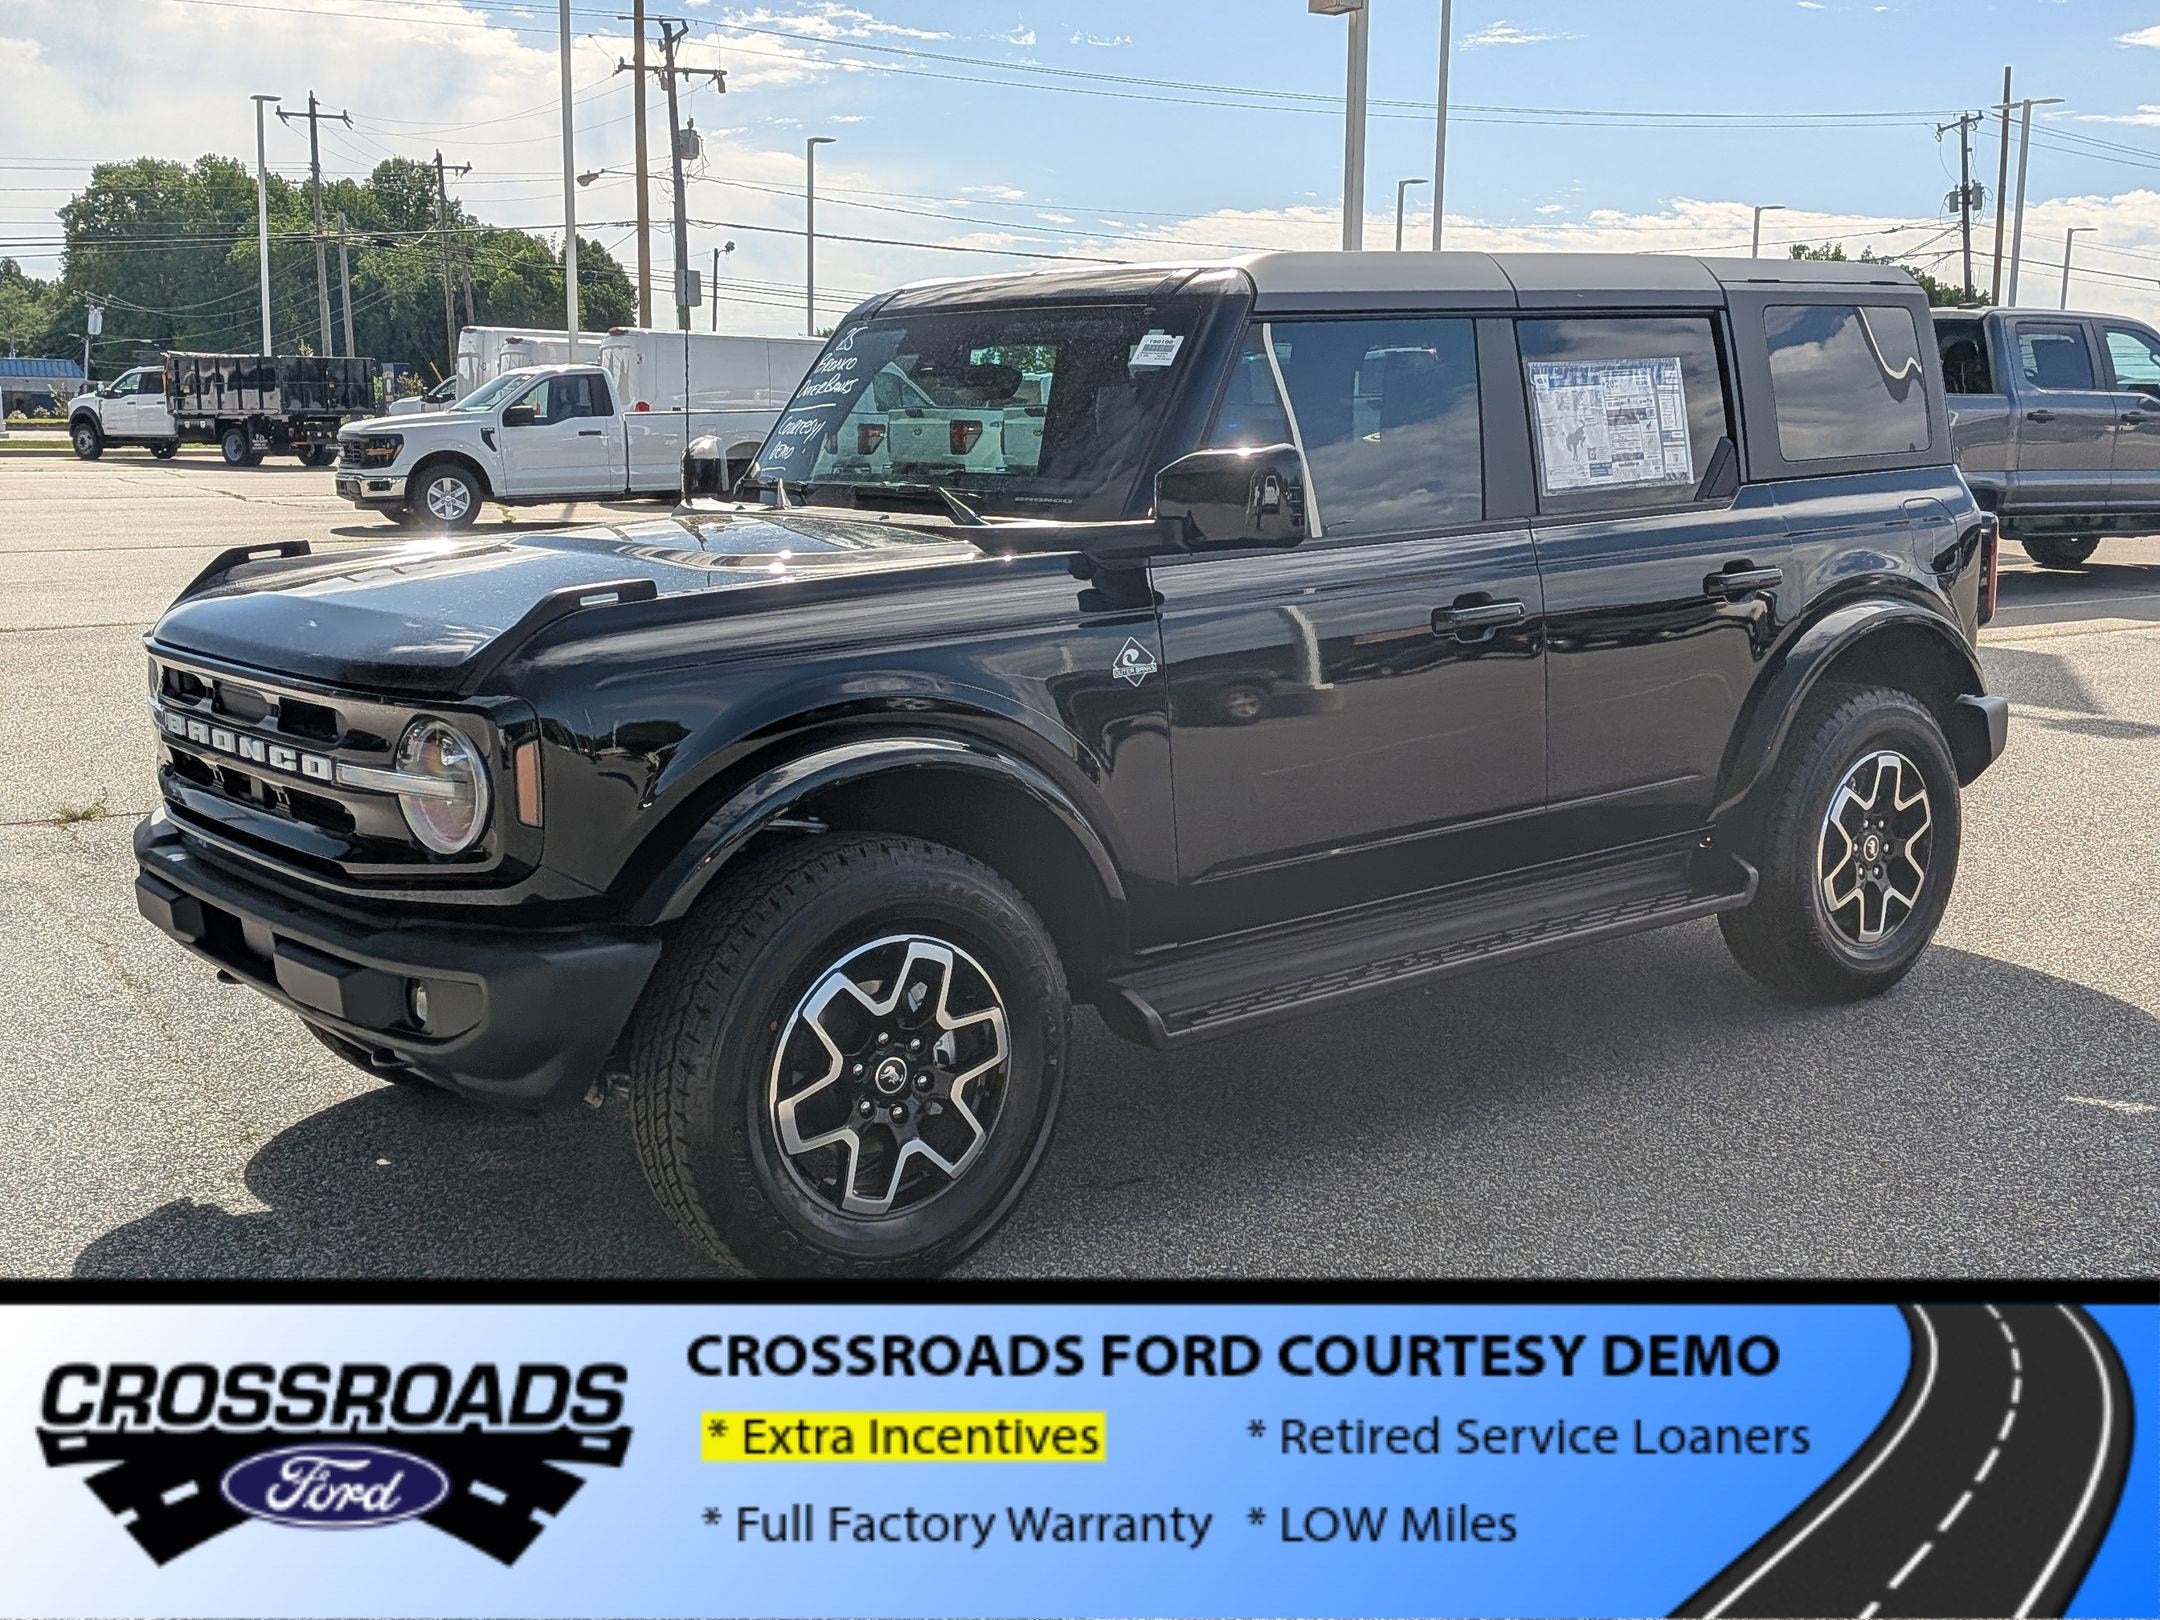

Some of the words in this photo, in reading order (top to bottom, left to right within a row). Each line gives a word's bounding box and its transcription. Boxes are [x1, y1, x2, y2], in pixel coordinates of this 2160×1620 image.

[836, 326, 869, 351] 25
[1014, 496, 1073, 504] BRONCO
[165, 711, 334, 782] BRONCO
